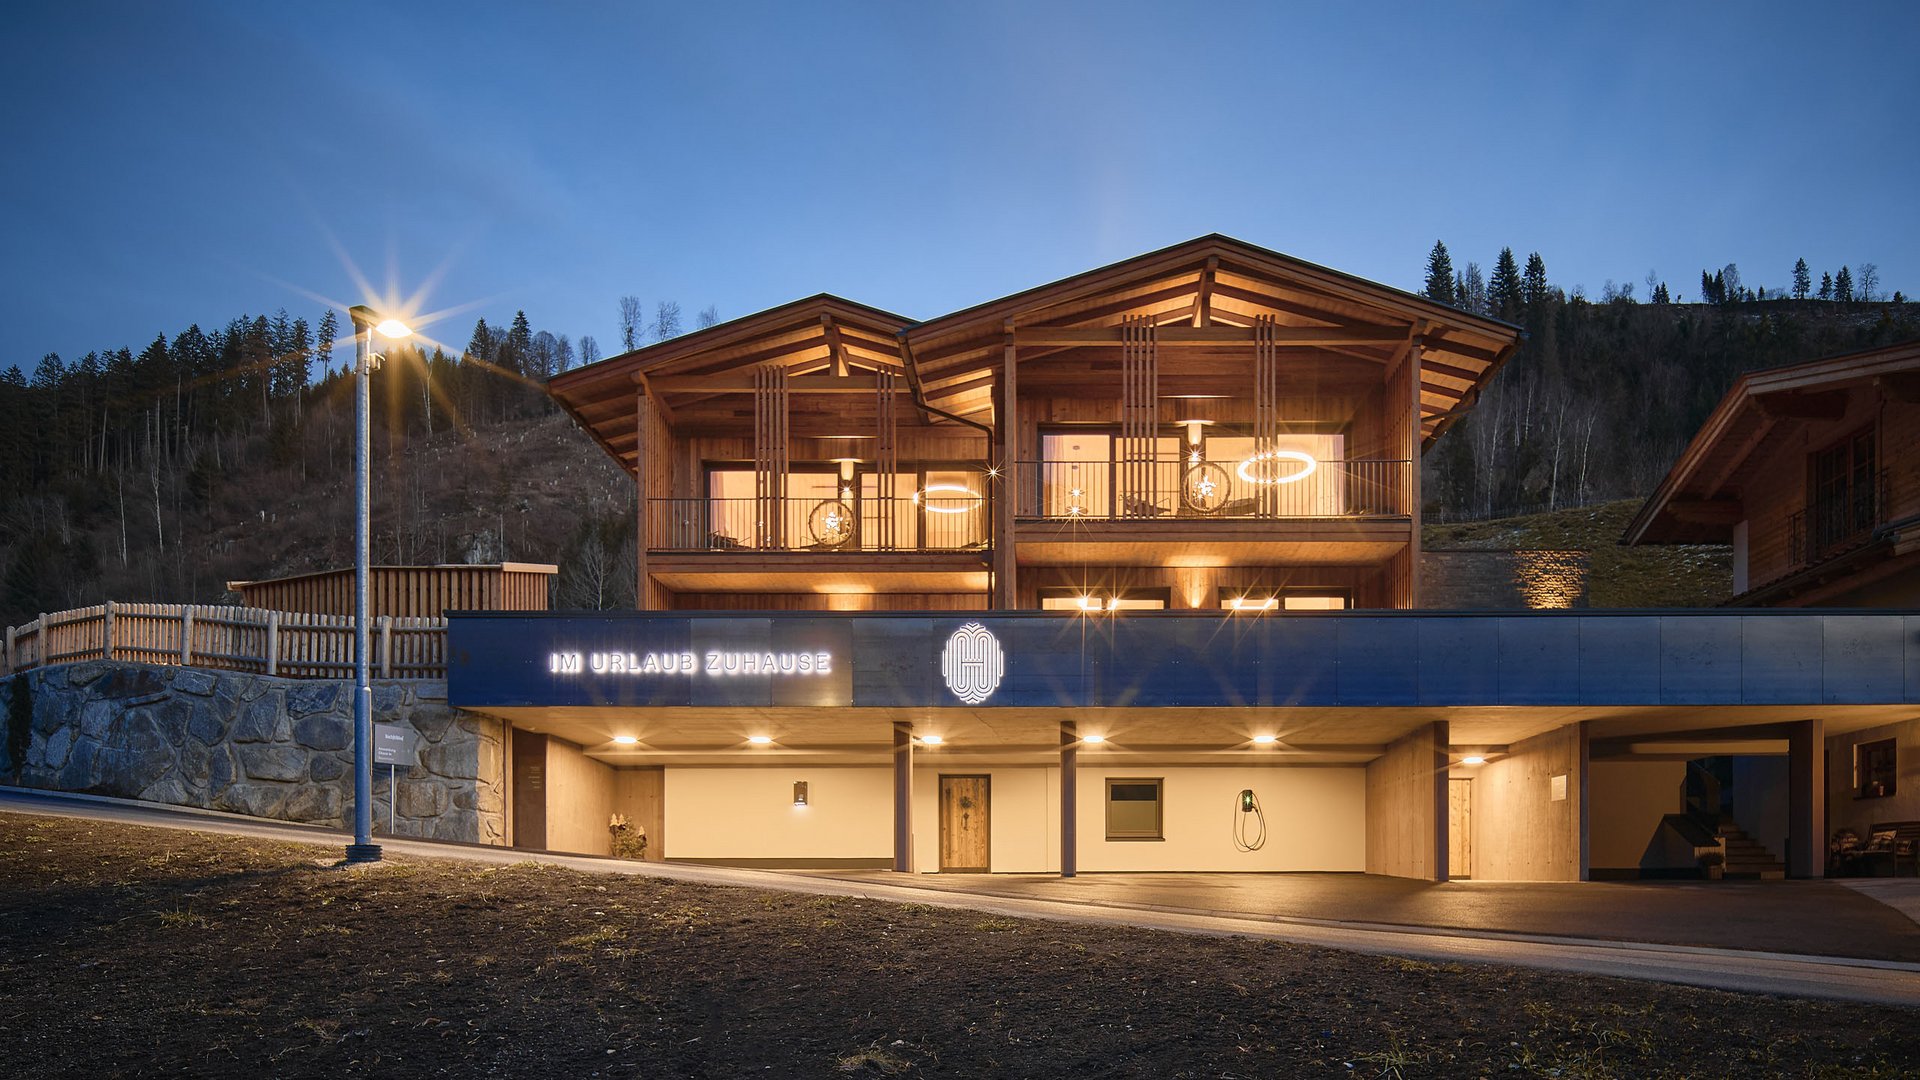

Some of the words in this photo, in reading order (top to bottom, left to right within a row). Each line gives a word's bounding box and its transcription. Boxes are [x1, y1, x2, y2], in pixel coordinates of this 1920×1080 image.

[549, 653, 580, 672] IM
[591, 653, 696, 673] URLAUB
[705, 653, 831, 673] ZUHAUSE
